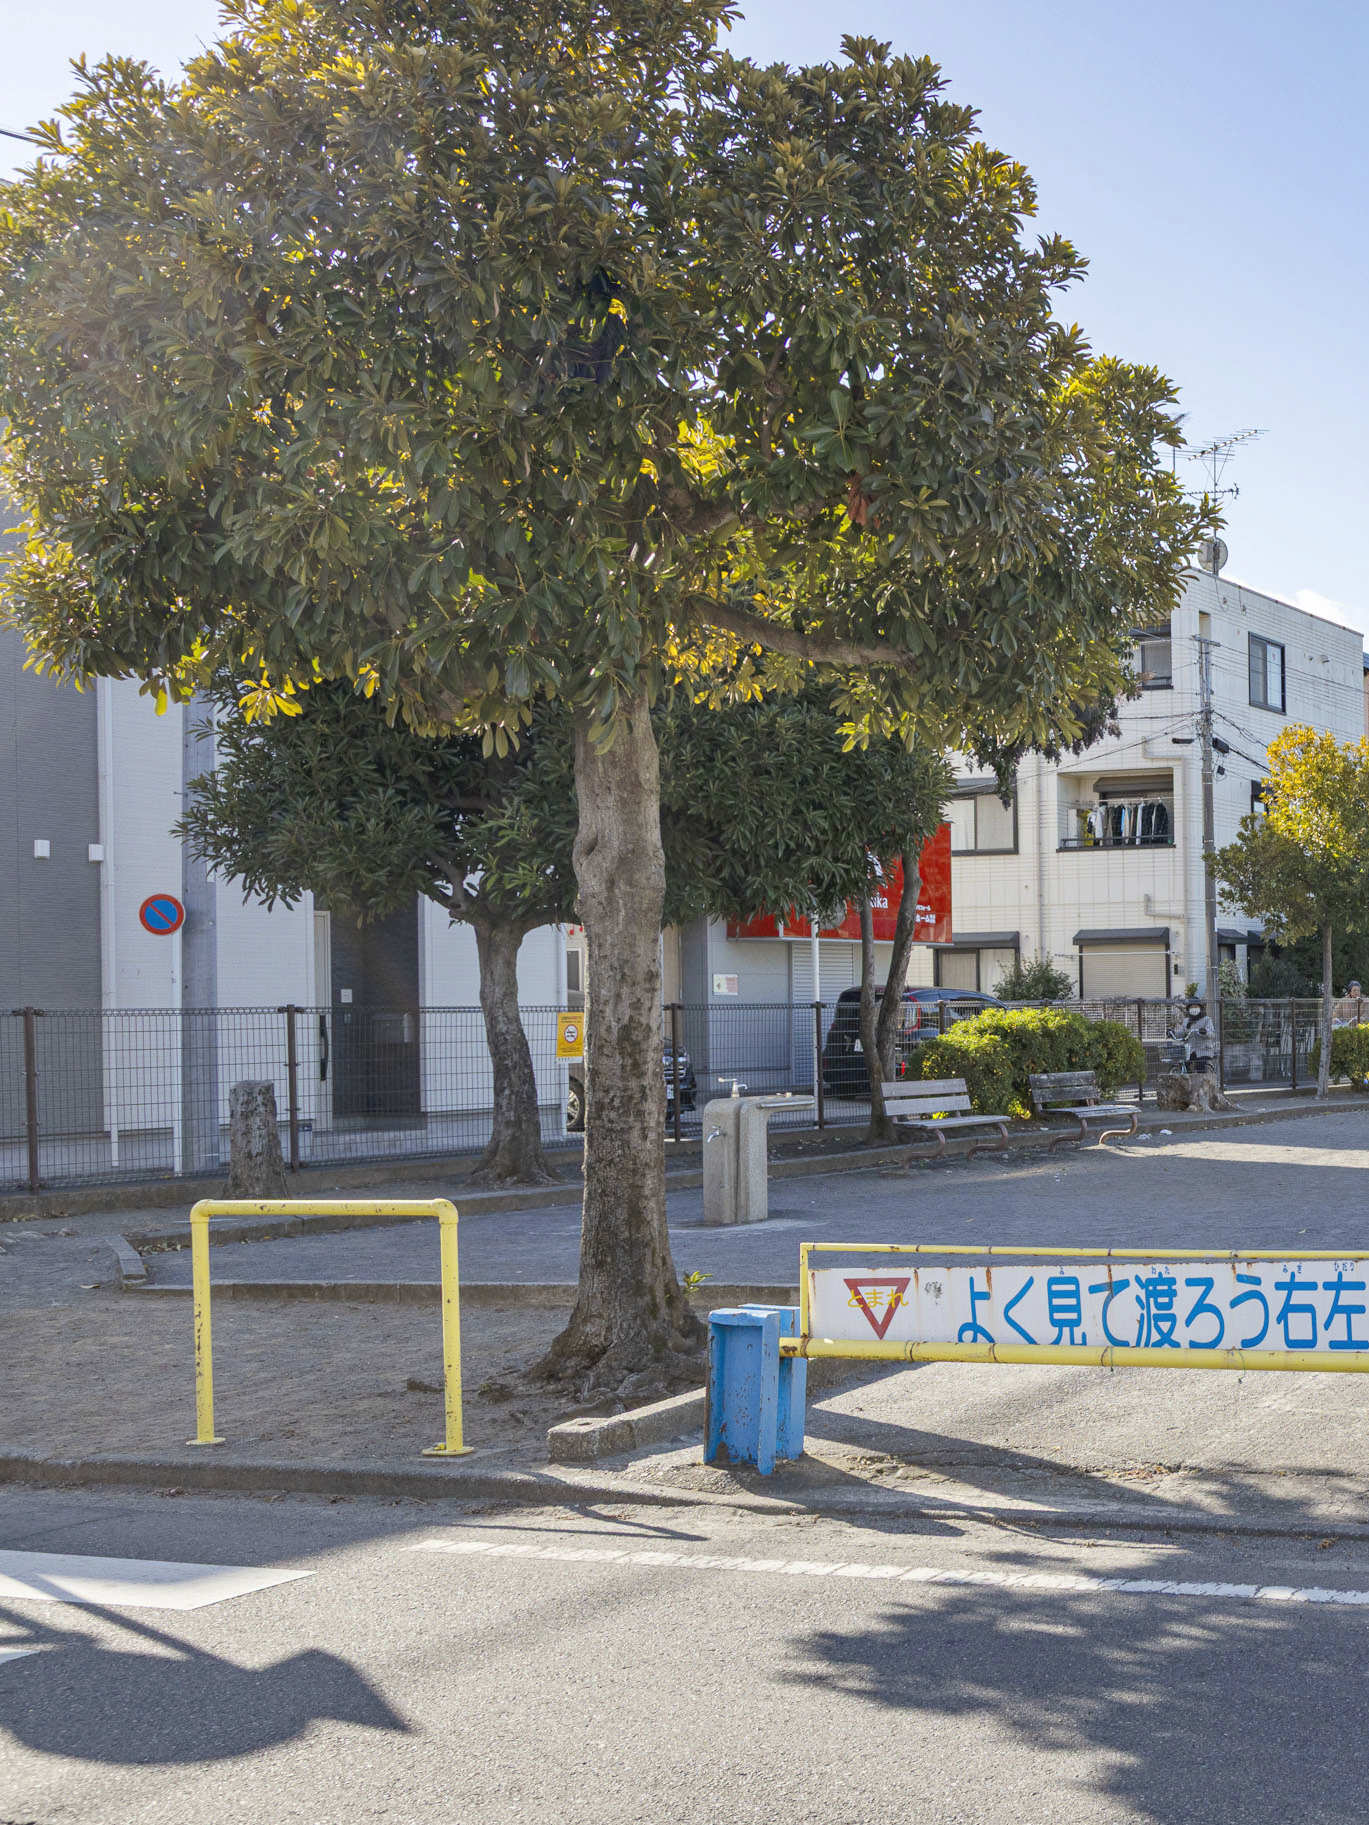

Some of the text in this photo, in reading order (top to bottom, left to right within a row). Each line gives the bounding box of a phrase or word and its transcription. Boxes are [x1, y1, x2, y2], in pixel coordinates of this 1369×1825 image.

[1333, 1261, 1355, 1272] ひだり
[847, 1288, 910, 1309] とまれ
[957, 1271, 1369, 1350] よく見て渡ろう右左
